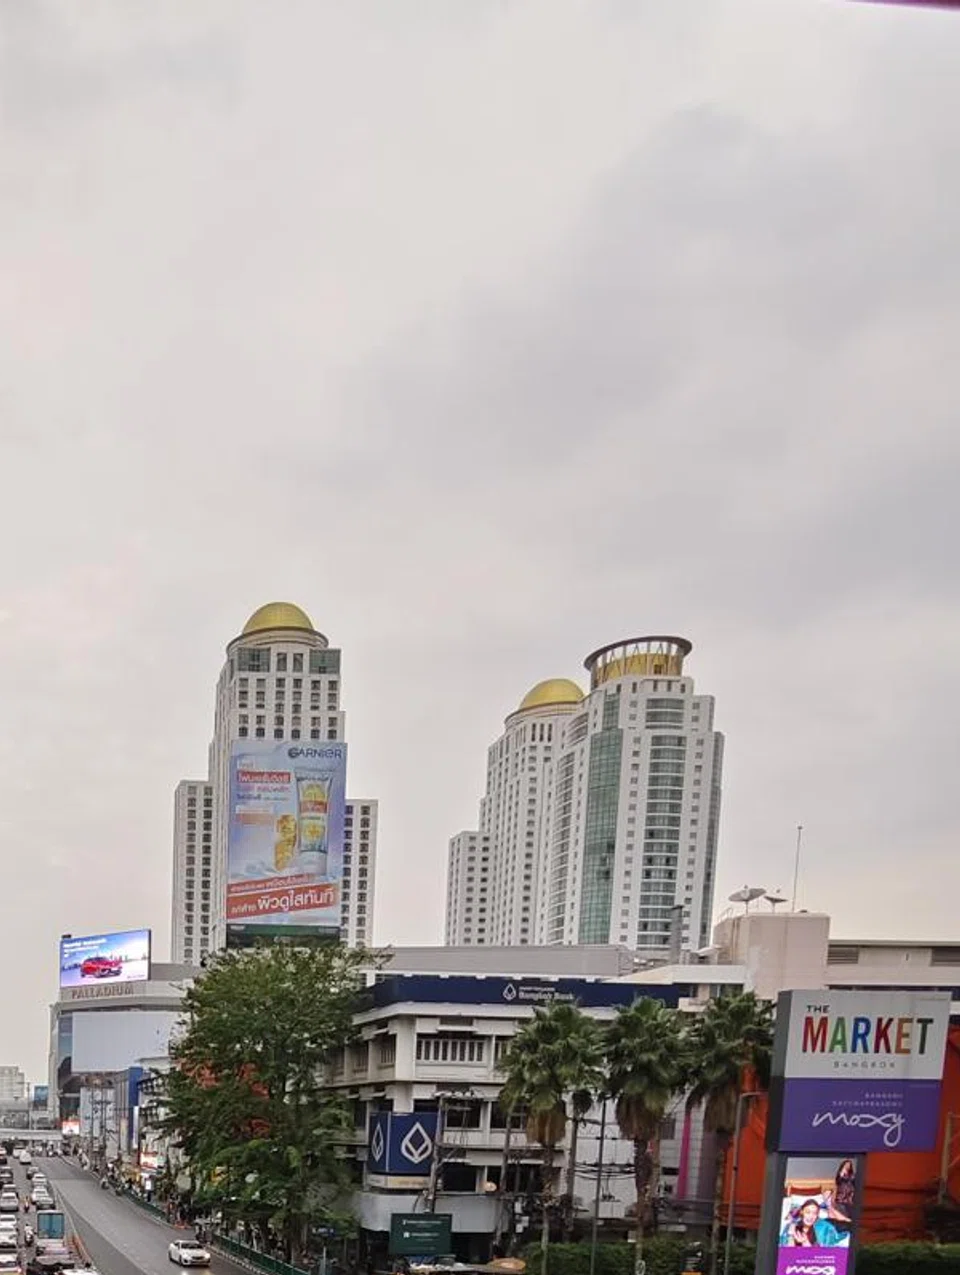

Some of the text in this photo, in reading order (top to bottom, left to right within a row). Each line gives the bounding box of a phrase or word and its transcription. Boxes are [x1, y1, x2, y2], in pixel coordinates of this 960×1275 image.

[806, 1004, 830, 1014] THE
[801, 1016, 935, 1056] MARKET
[811, 1111, 906, 1147] moxy
